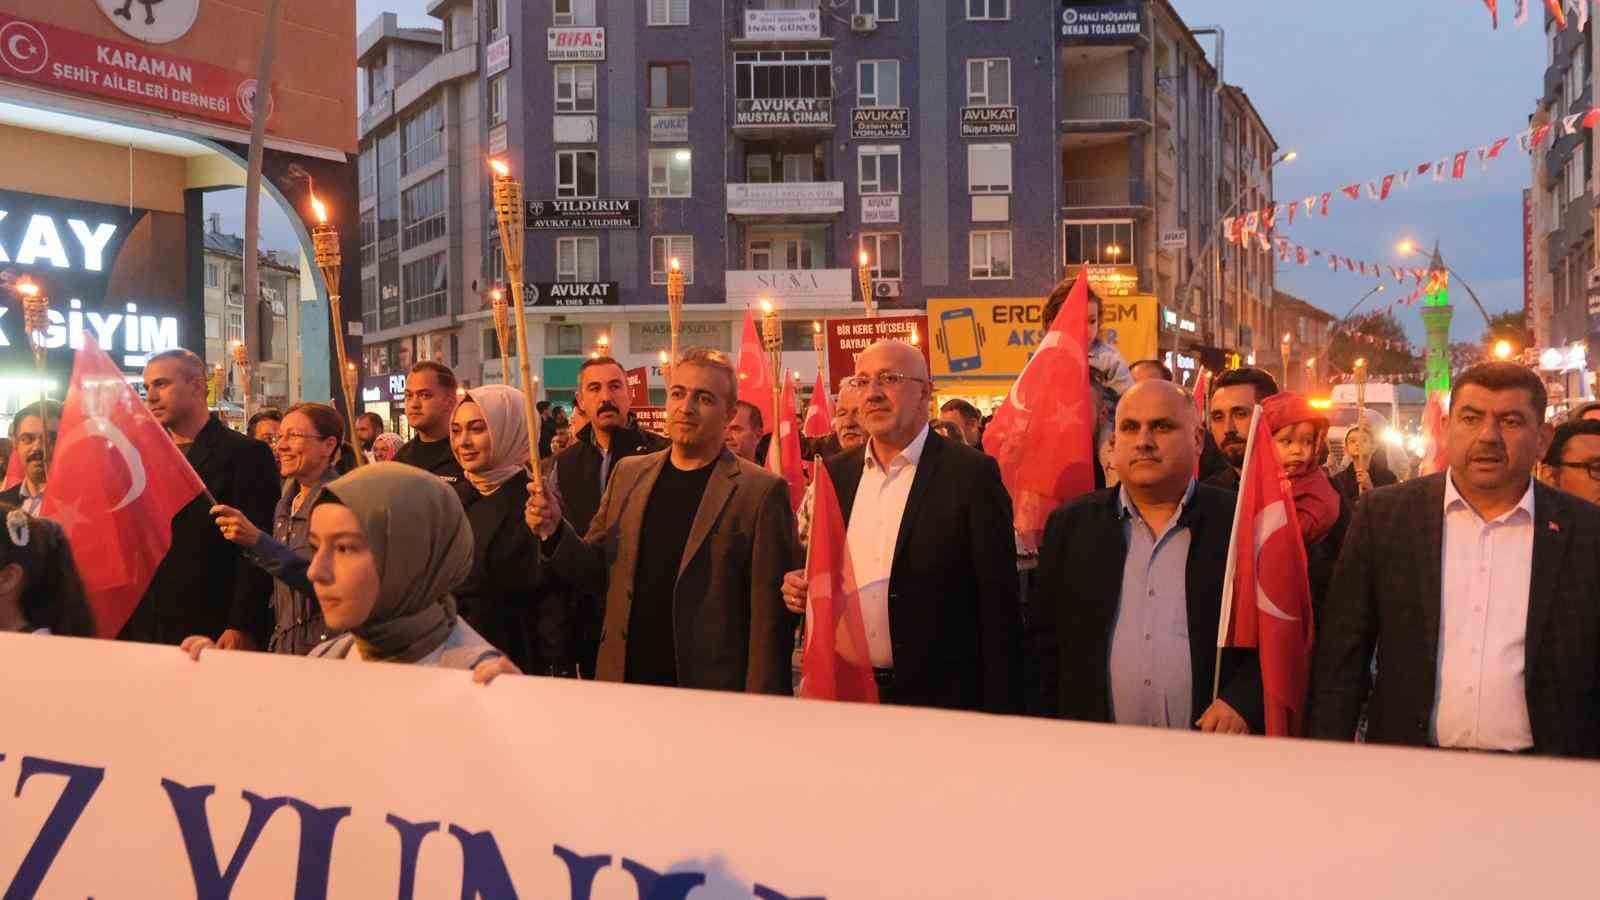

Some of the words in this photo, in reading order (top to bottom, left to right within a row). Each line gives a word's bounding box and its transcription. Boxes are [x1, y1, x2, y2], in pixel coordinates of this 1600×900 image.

[96, 45, 192, 83] KARAMAN
[52, 62, 100, 85] ŞEHİT
[102, 74, 168, 101] AİLELERİ
[171, 90, 230, 113] DERNEĞİ
[751, 98, 816, 111] AVUKAT
[737, 112, 790, 122] MUSTAFA
[855, 111, 906, 121] AVUKAT
[964, 109, 1016, 121] AVUKAT
[552, 200, 630, 211] YILDIRIM
[535, 219, 570, 227] AVUKAT
[550, 284, 610, 297] AVUKAT
[32, 298, 178, 352] GİYİM
[837, 324, 851, 336] BİR
[852, 323, 874, 335] KERE
[0, 753, 106, 900] Z
